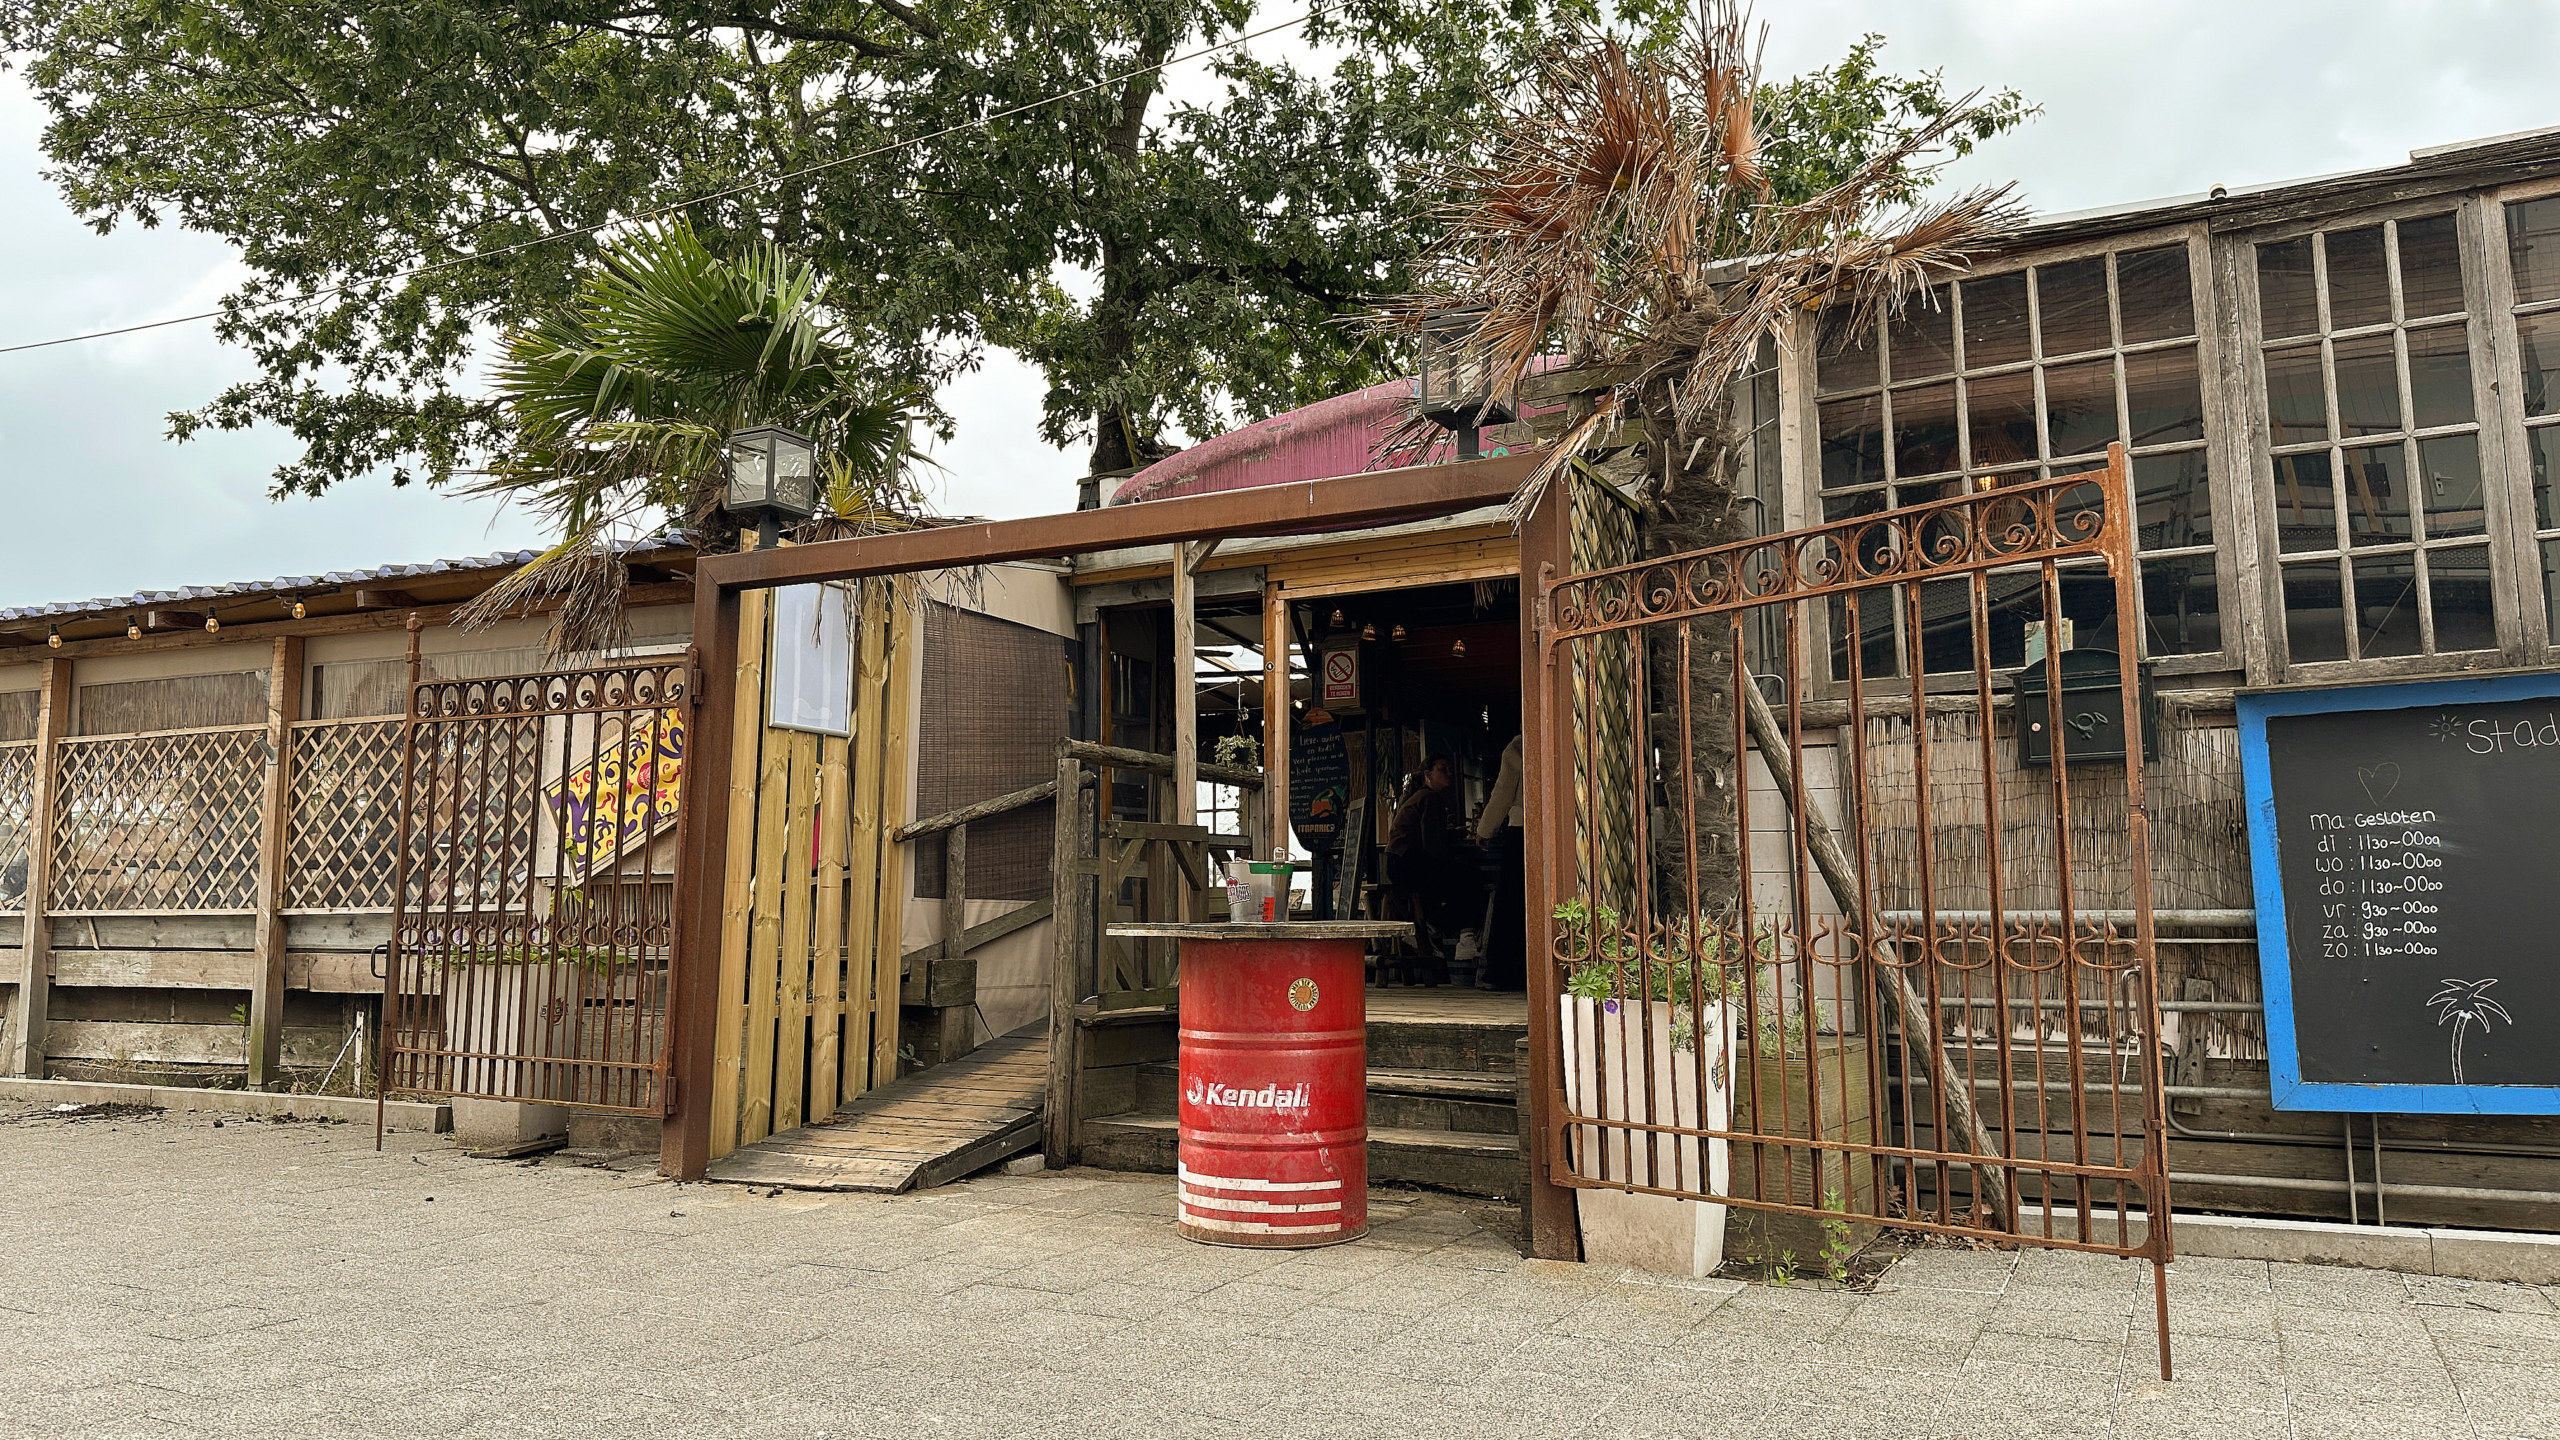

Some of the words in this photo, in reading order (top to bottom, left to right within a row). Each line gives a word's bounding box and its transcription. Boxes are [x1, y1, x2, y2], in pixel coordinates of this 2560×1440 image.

[2310, 813, 2346, 830] ma
[2354, 810, 2436, 828] Gesloten
[2317, 834, 2336, 852] di
[2315, 857, 2343, 872] wo
[2319, 876, 2345, 896] do
[2322, 903, 2346, 919] vr
[2322, 924, 2349, 939] za
[2322, 942, 2348, 958] zo
[1206, 1082, 1311, 1107] Kendall
